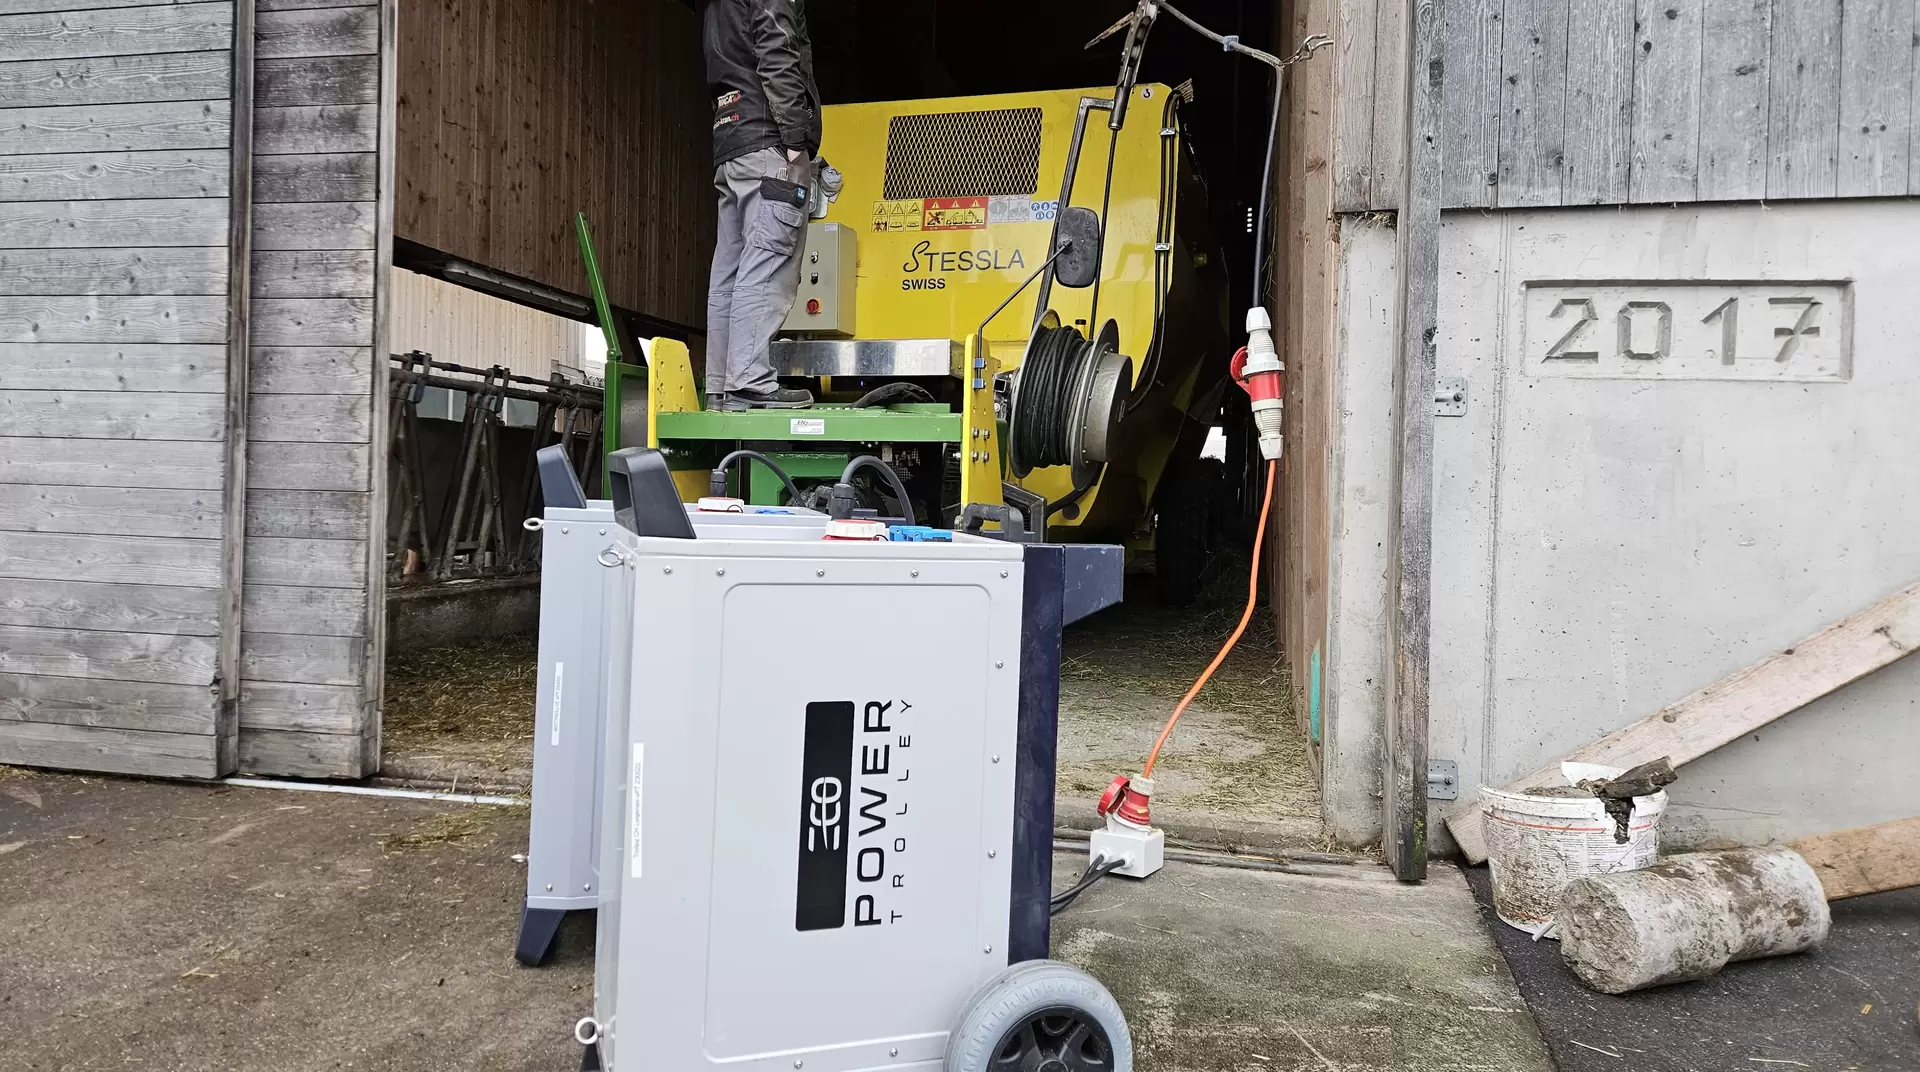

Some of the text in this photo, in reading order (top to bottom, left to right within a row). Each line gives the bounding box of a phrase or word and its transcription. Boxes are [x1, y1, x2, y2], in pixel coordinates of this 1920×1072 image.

[901, 278, 946, 290] SWISS
[902, 240, 1025, 273] STESSLA
[1540, 297, 1824, 366] 2017
[854, 700, 893, 927] POWER
[891, 699, 912, 924] TROLLEY
